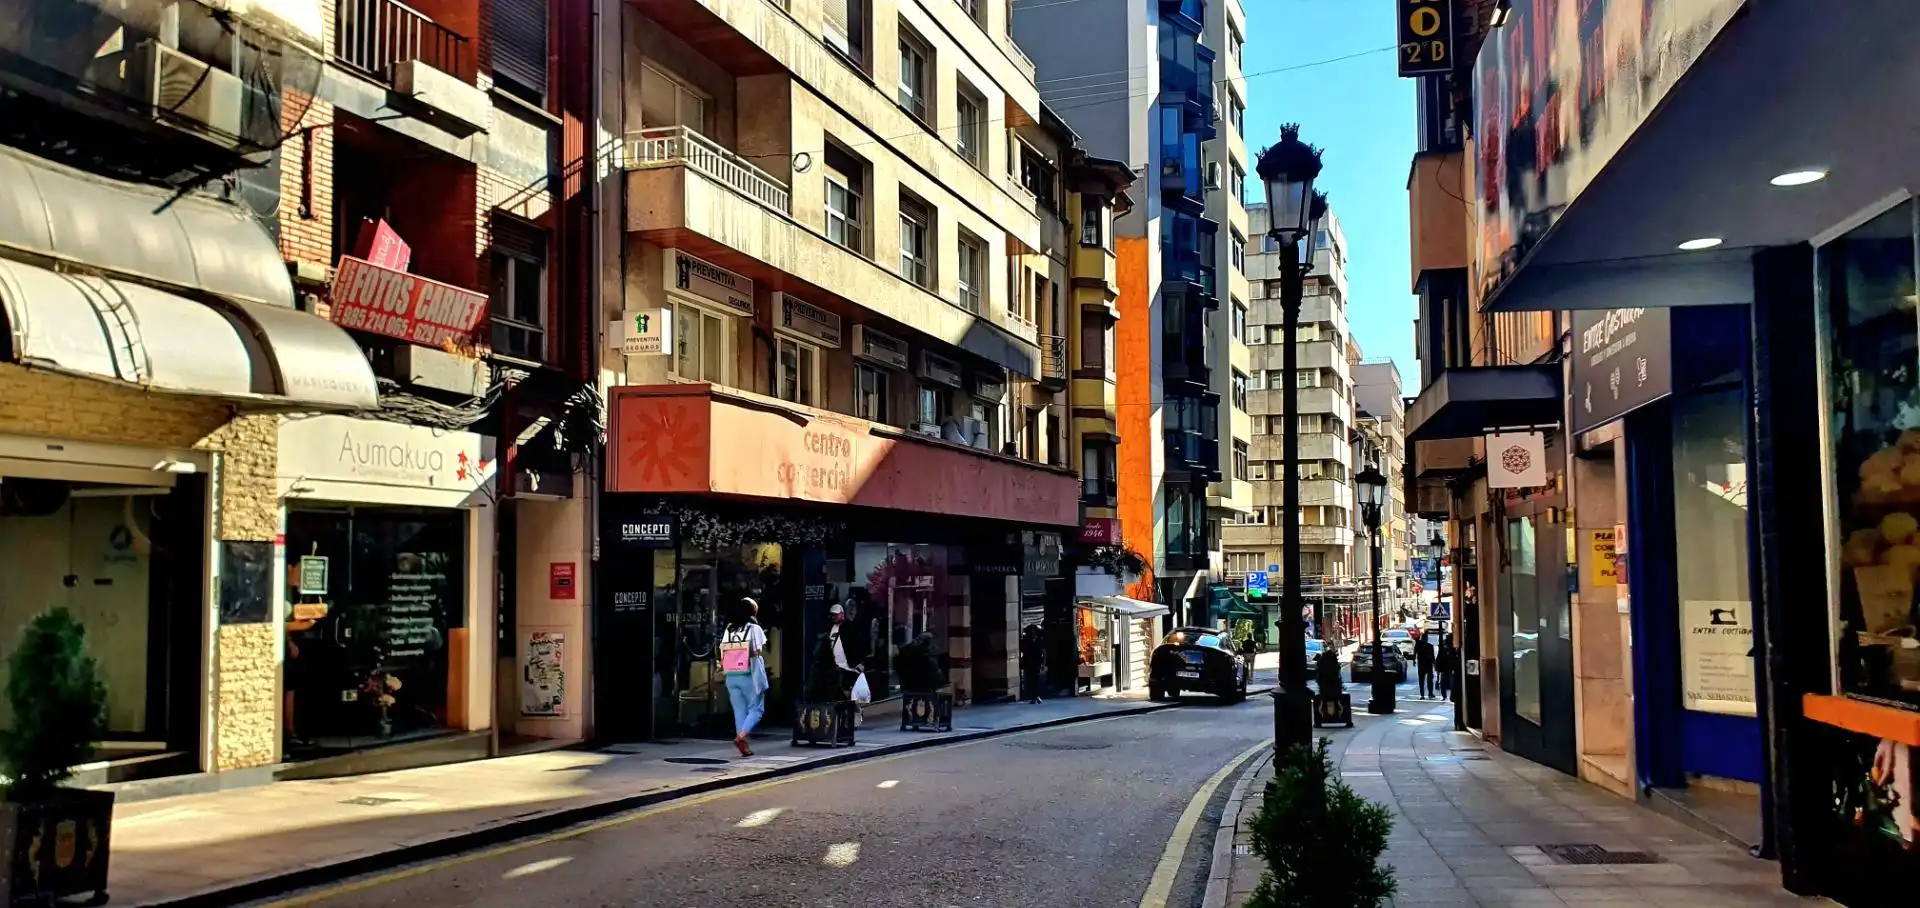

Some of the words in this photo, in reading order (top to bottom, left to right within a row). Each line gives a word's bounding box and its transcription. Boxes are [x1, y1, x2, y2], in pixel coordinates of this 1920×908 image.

[692, 259, 736, 288] PREVENTIVA
[349, 263, 414, 315] FOTOS
[415, 282, 485, 330] CARNET
[728, 295, 751, 310] SEGUROS
[1583, 319, 1605, 354] ENTRE
[338, 430, 444, 472] Aumakua
[804, 430, 851, 458] centro
[622, 523, 671, 534] CONCEPTO
[1084, 529, 1104, 538] 1946
[1249, 572, 1258, 583] P
[1600, 569, 1617, 577] PLA
[614, 591, 647, 604] CONCEPTO
